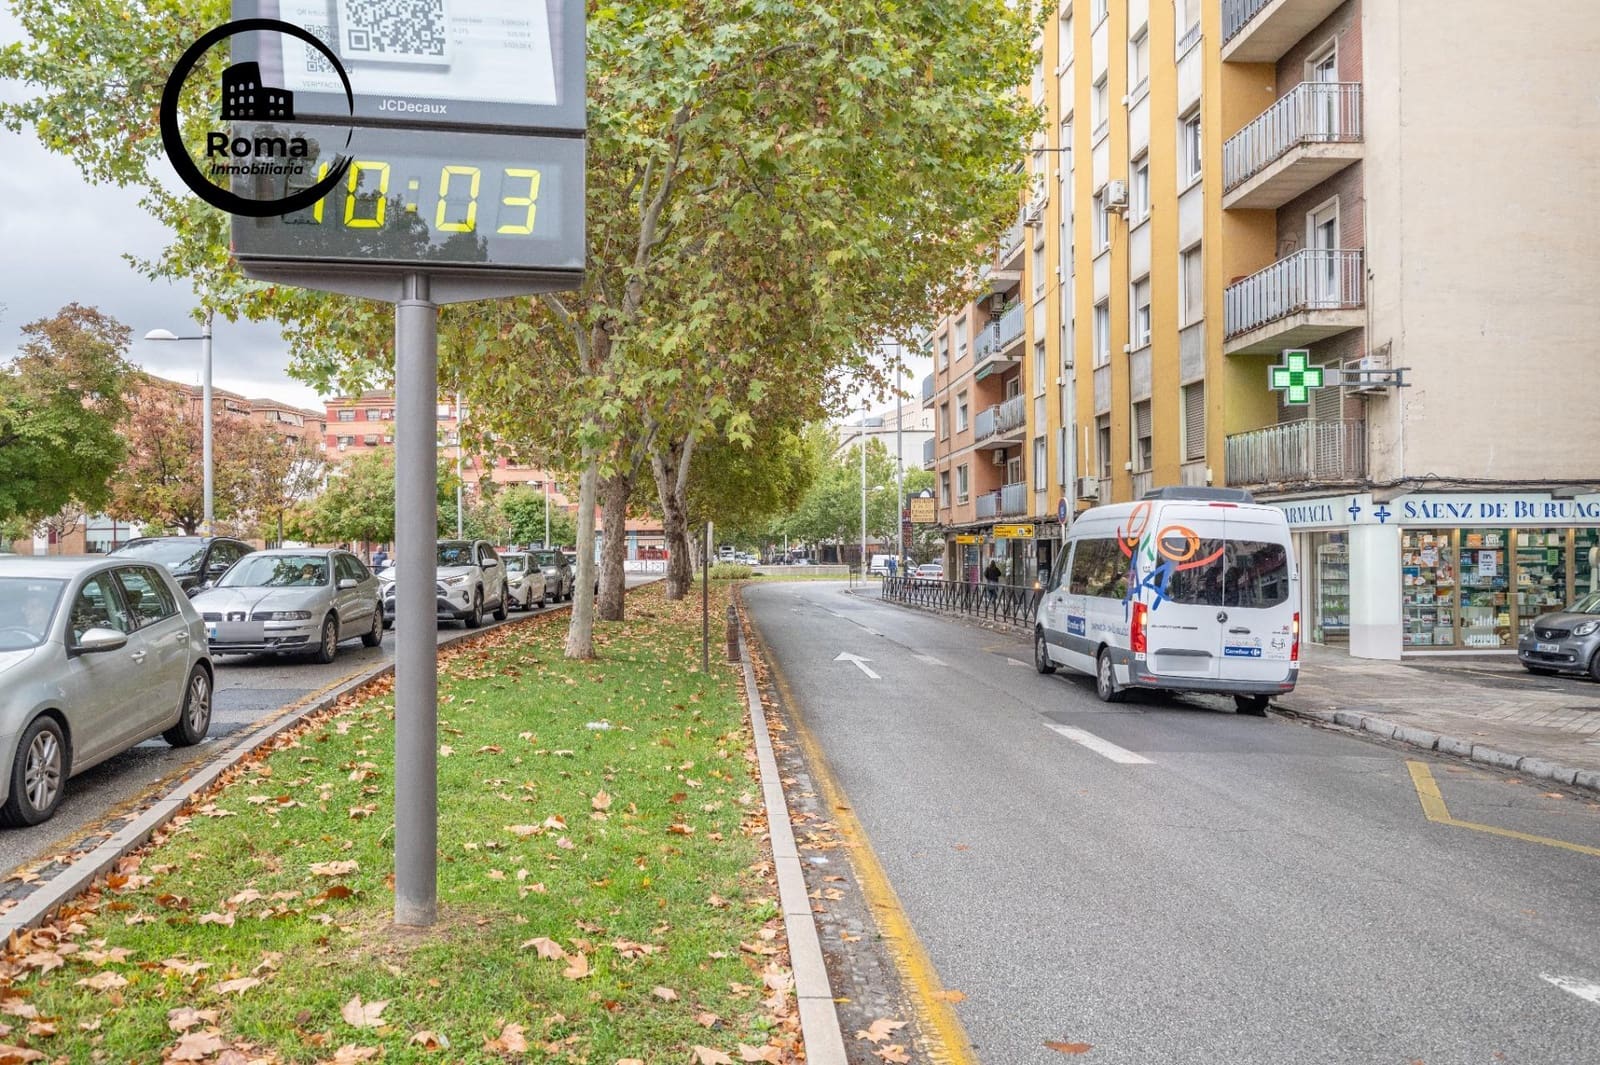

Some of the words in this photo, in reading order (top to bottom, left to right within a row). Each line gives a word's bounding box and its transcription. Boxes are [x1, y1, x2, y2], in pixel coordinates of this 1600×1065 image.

[378, 99, 447, 114] JCDecaux
[313, 160, 541, 235] 10:03
[1282, 504, 1333, 524] ARMACIA
[1404, 499, 1473, 519] SÁENZ
[1480, 502, 1507, 518] DE
